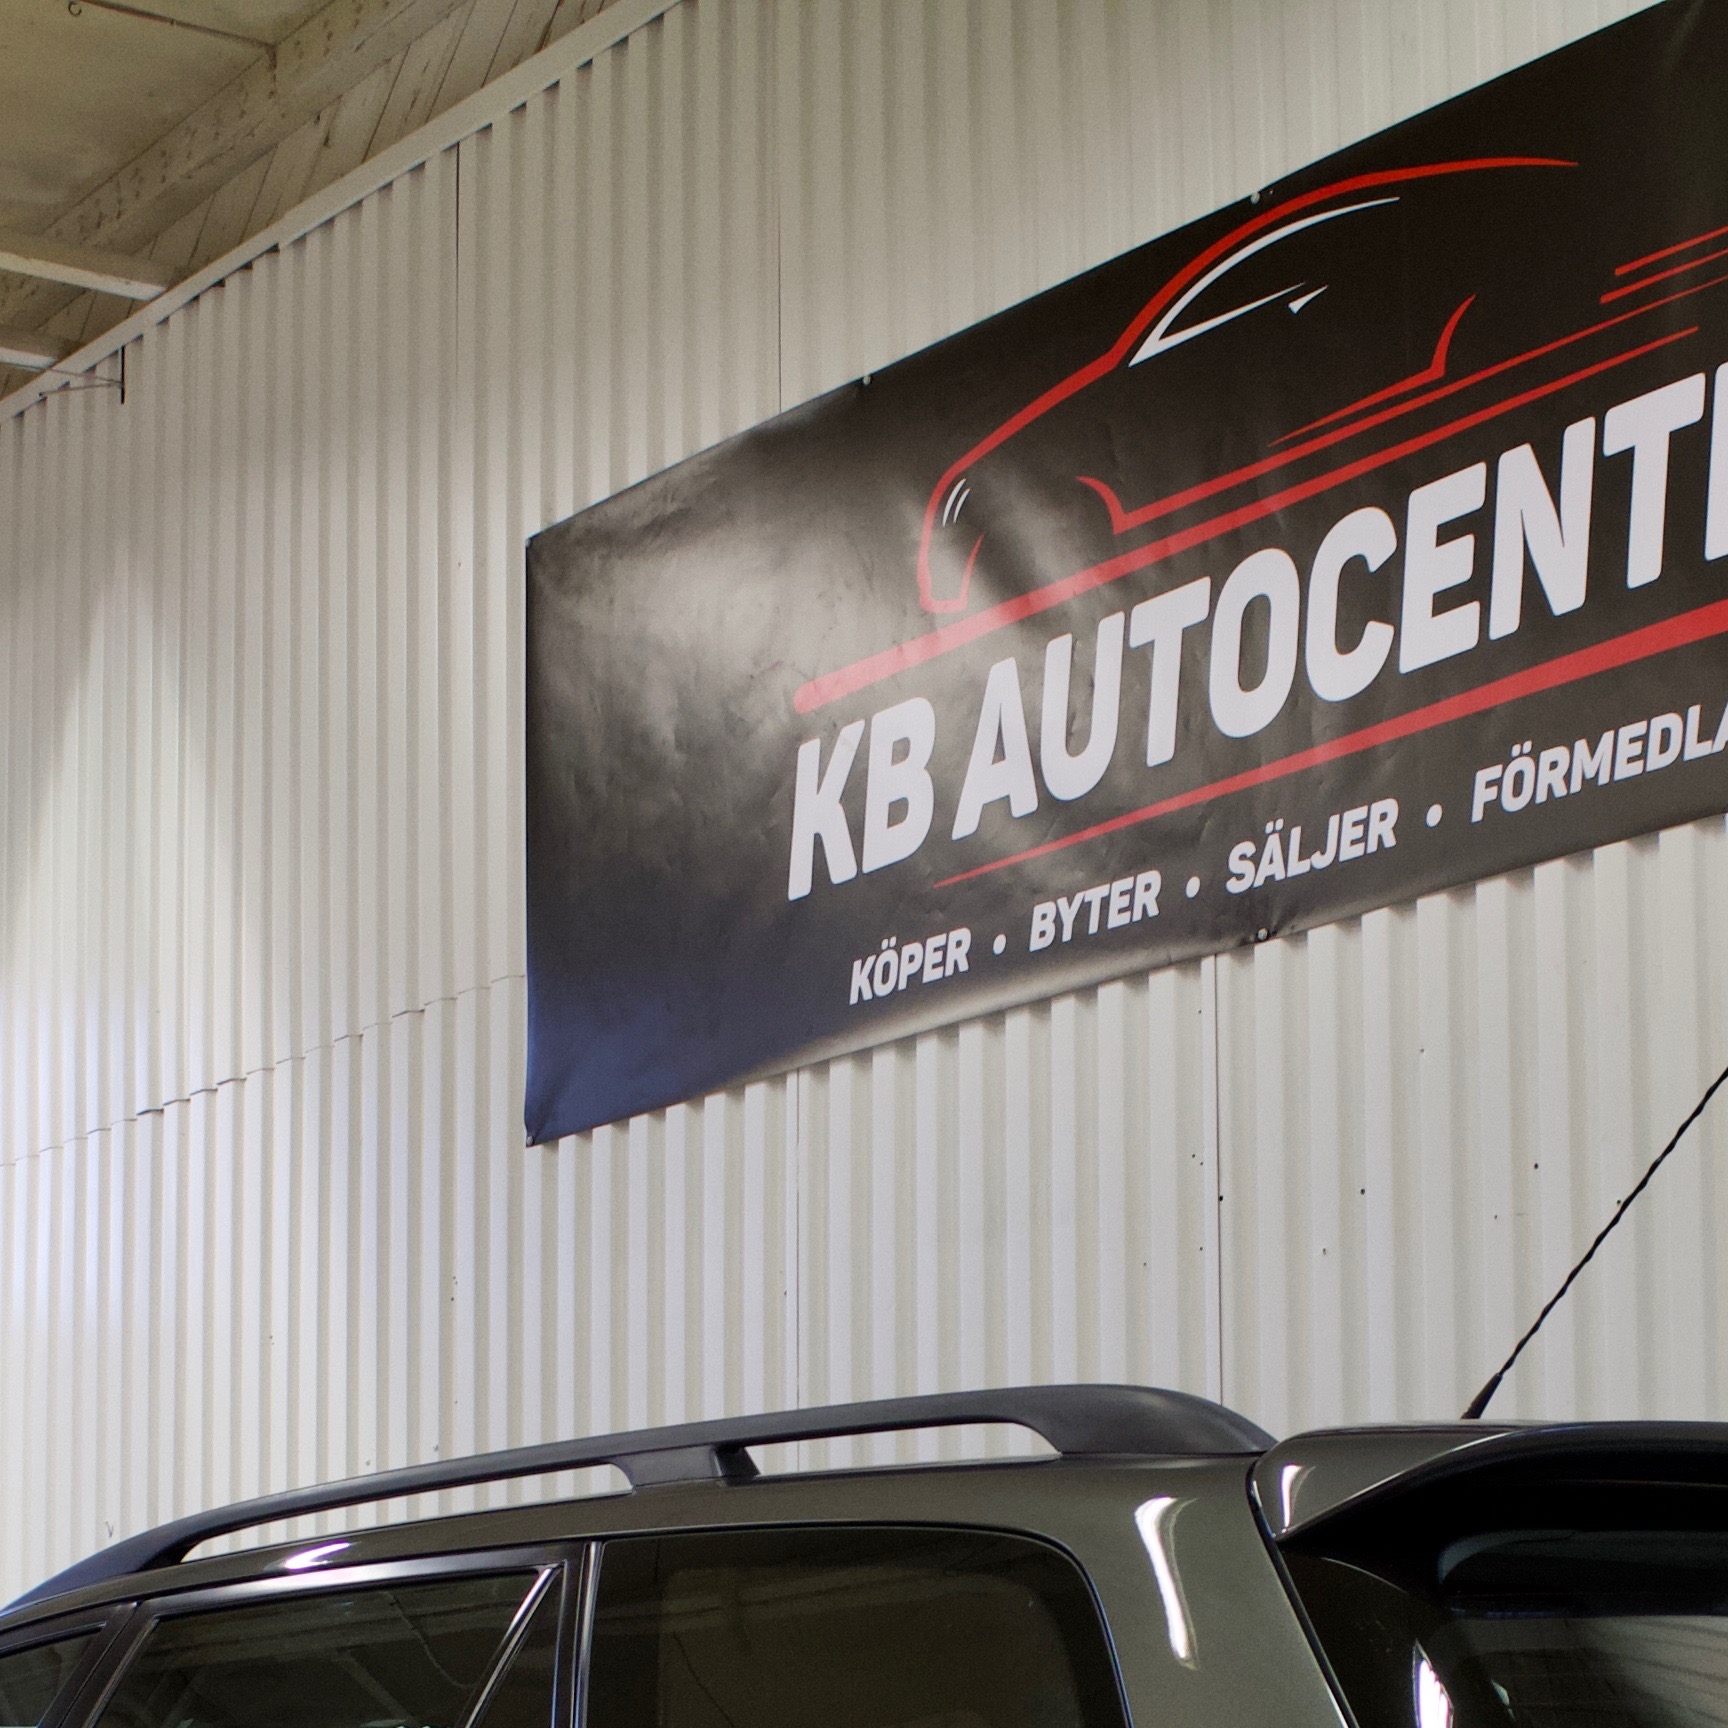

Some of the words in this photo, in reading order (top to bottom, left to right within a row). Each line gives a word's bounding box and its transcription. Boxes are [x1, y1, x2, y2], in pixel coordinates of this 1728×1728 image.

[786, 695, 936, 902] KB
[849, 928, 970, 1004] KÖPER
[1029, 870, 1161, 952] BYTER
[1226, 798, 1399, 894] SÄLJER
